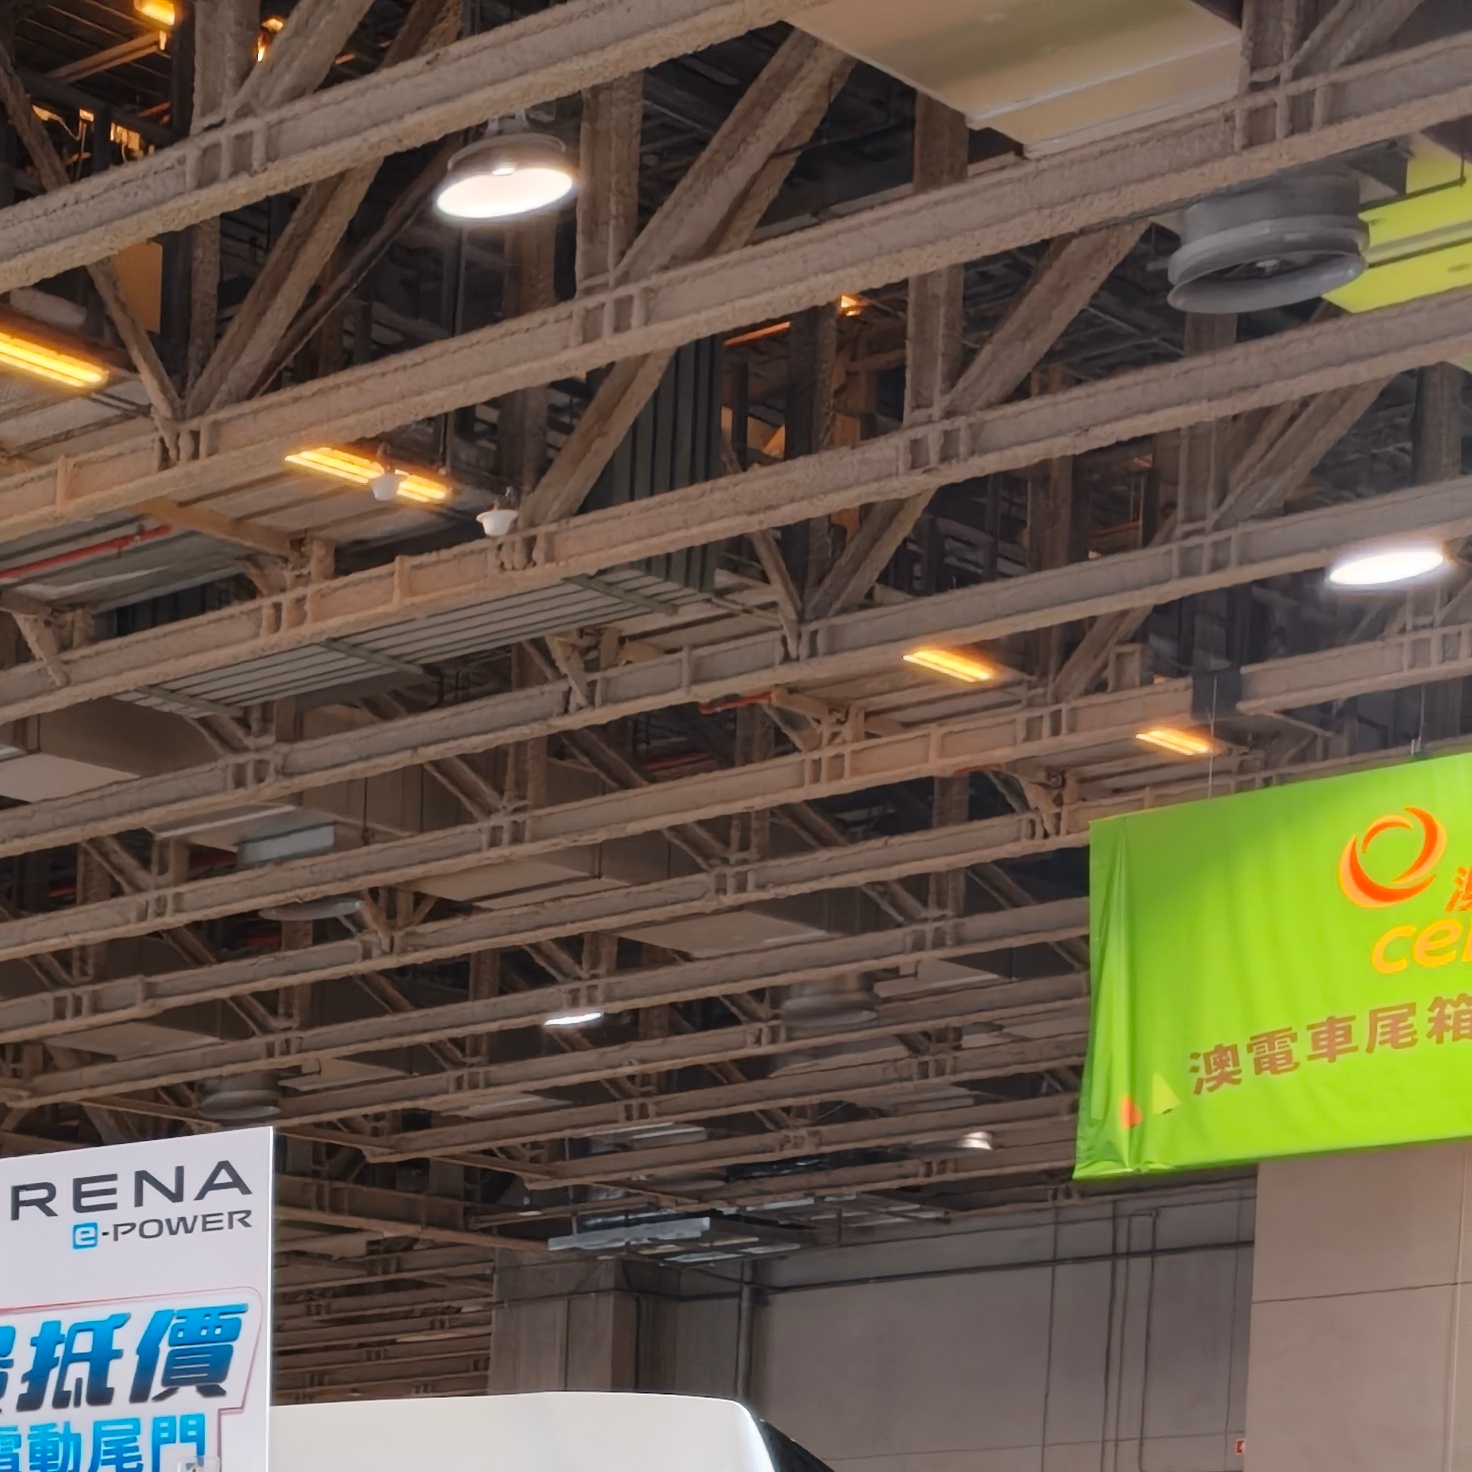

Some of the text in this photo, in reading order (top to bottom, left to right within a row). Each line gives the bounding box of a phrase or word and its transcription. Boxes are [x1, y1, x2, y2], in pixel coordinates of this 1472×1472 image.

[1189, 993, 1472, 1095] 澳電車尾箱
[72, 1208, 253, 1250] e-POWER
